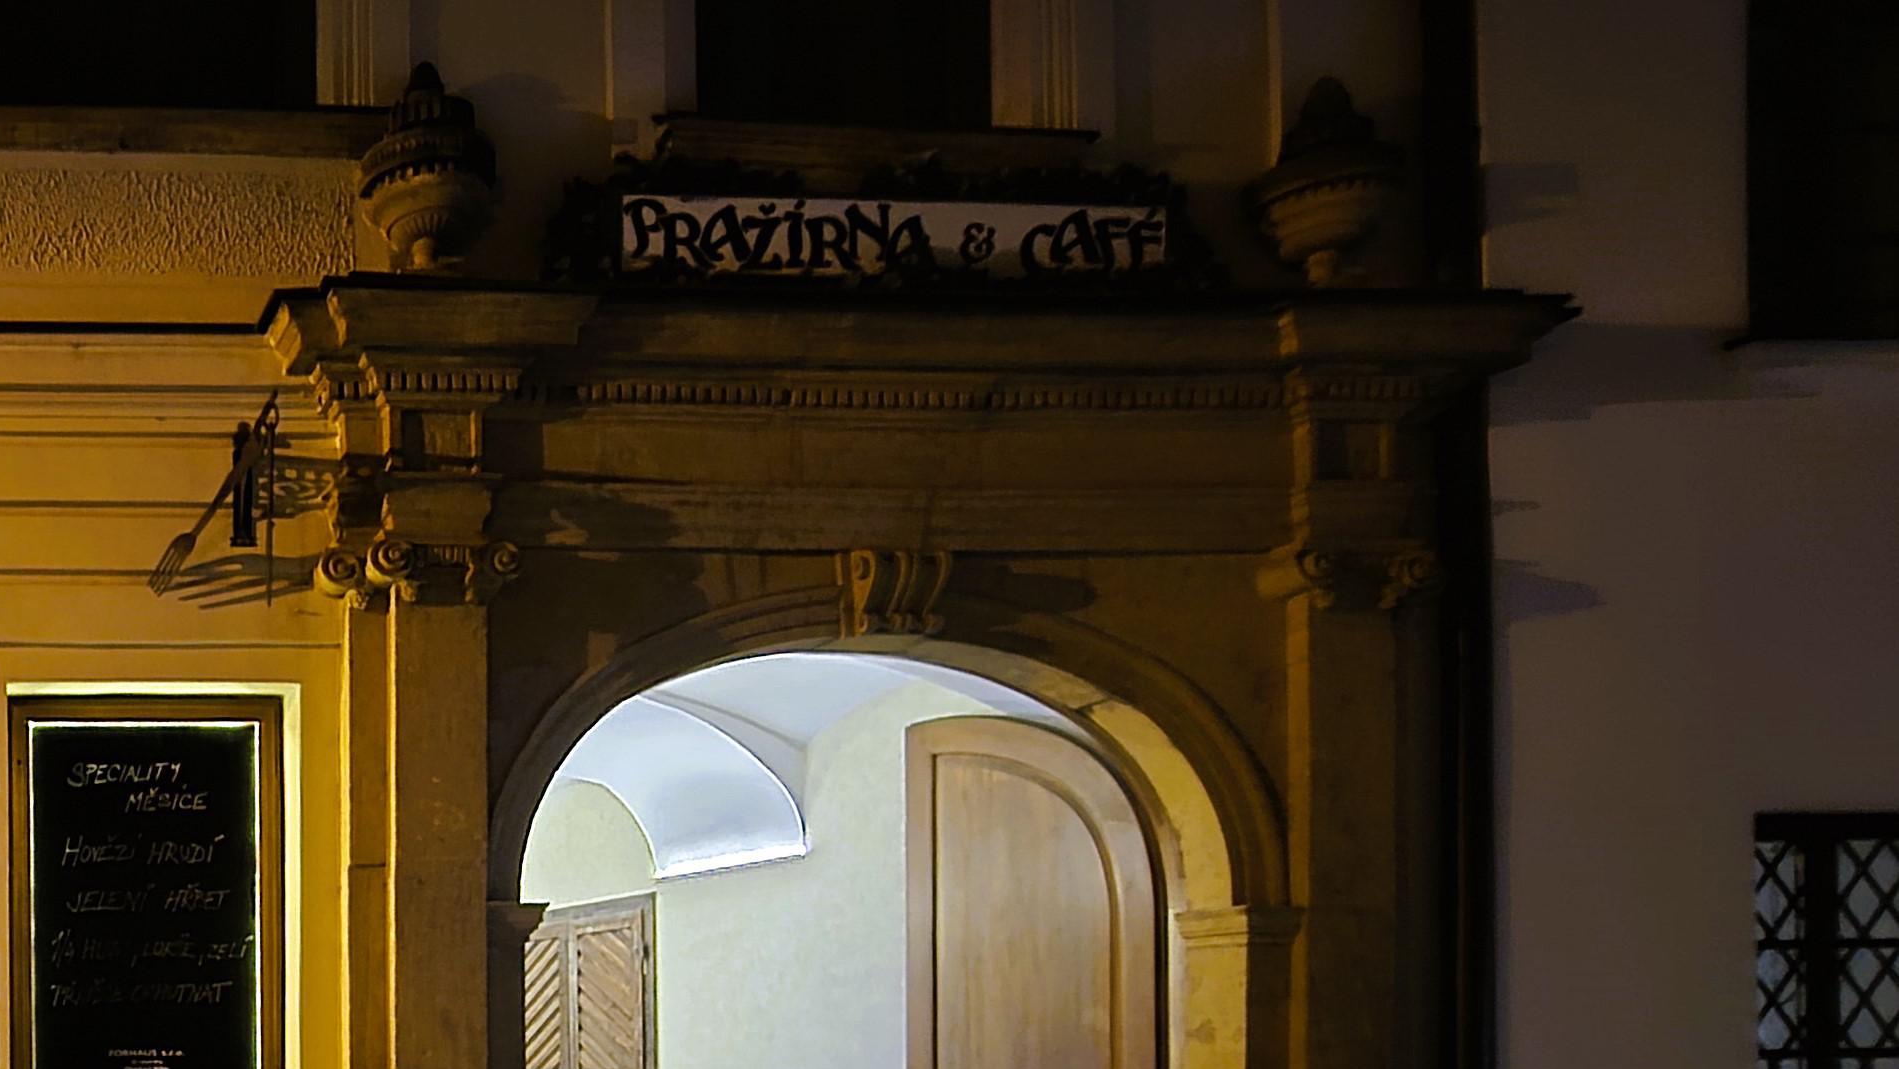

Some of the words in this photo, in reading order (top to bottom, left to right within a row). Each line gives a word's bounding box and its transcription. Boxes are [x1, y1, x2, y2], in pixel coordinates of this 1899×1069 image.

[623, 198, 940, 272] PRAŽÍRNA
[961, 222, 996, 264] &
[1020, 206, 1164, 272] CAFÉ
[66, 761, 181, 787] SPECIALITY
